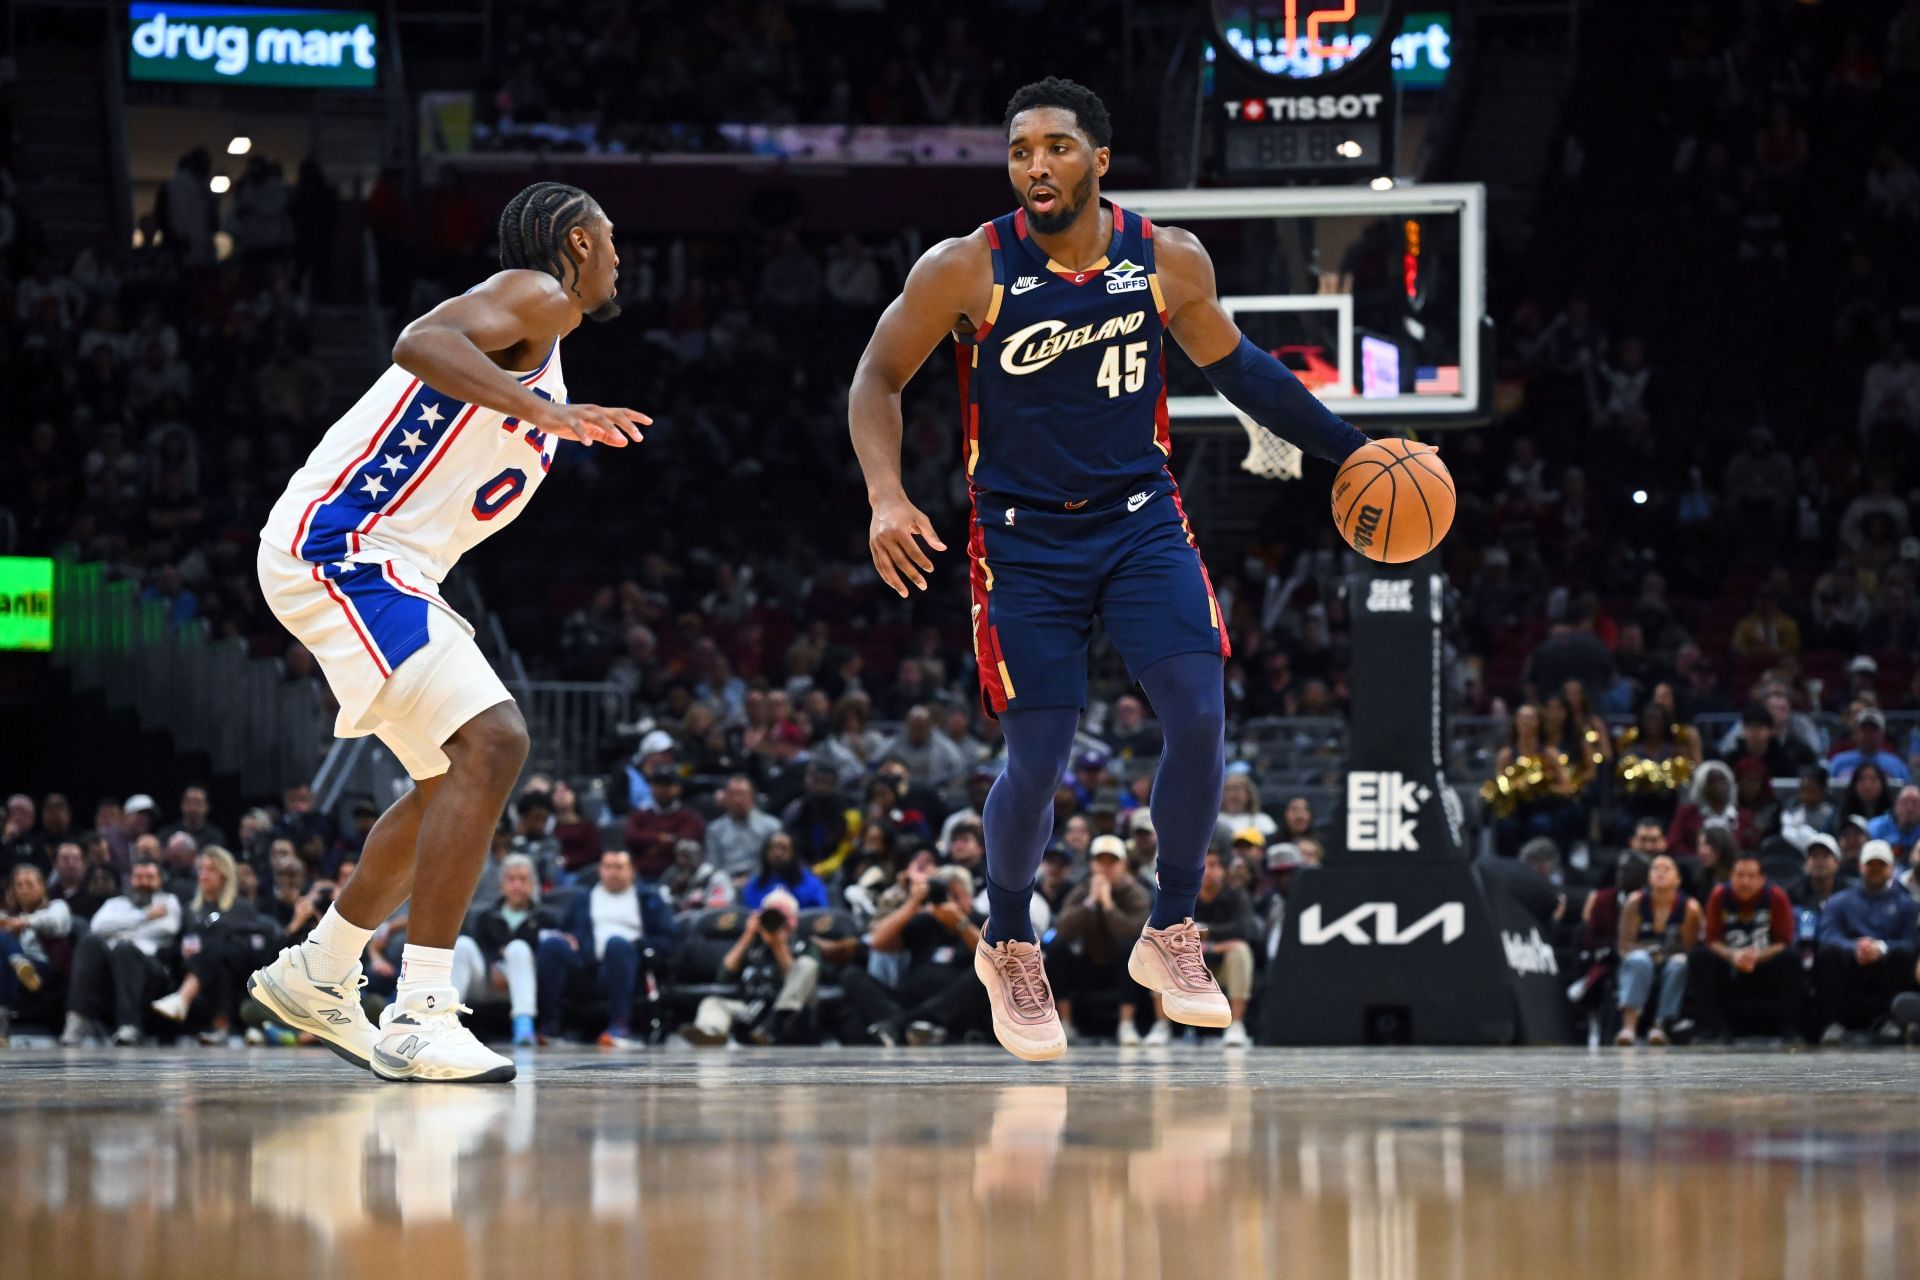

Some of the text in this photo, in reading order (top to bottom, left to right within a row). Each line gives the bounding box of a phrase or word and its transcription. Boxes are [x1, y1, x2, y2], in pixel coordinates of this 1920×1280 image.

[132, 12, 376, 75] drug mart
[1267, 94, 1382, 120] TISSOT
[1016, 276, 1039, 288] NIKE
[1107, 279, 1147, 291] CLIFFS
[1000, 310, 1145, 376] CLEVELAND
[1096, 341, 1149, 399] 45
[471, 468, 528, 521] 0
[1128, 492, 1148, 504] NIKE
[1346, 812, 1420, 851] Elk
[1299, 902, 1465, 945] KIA
